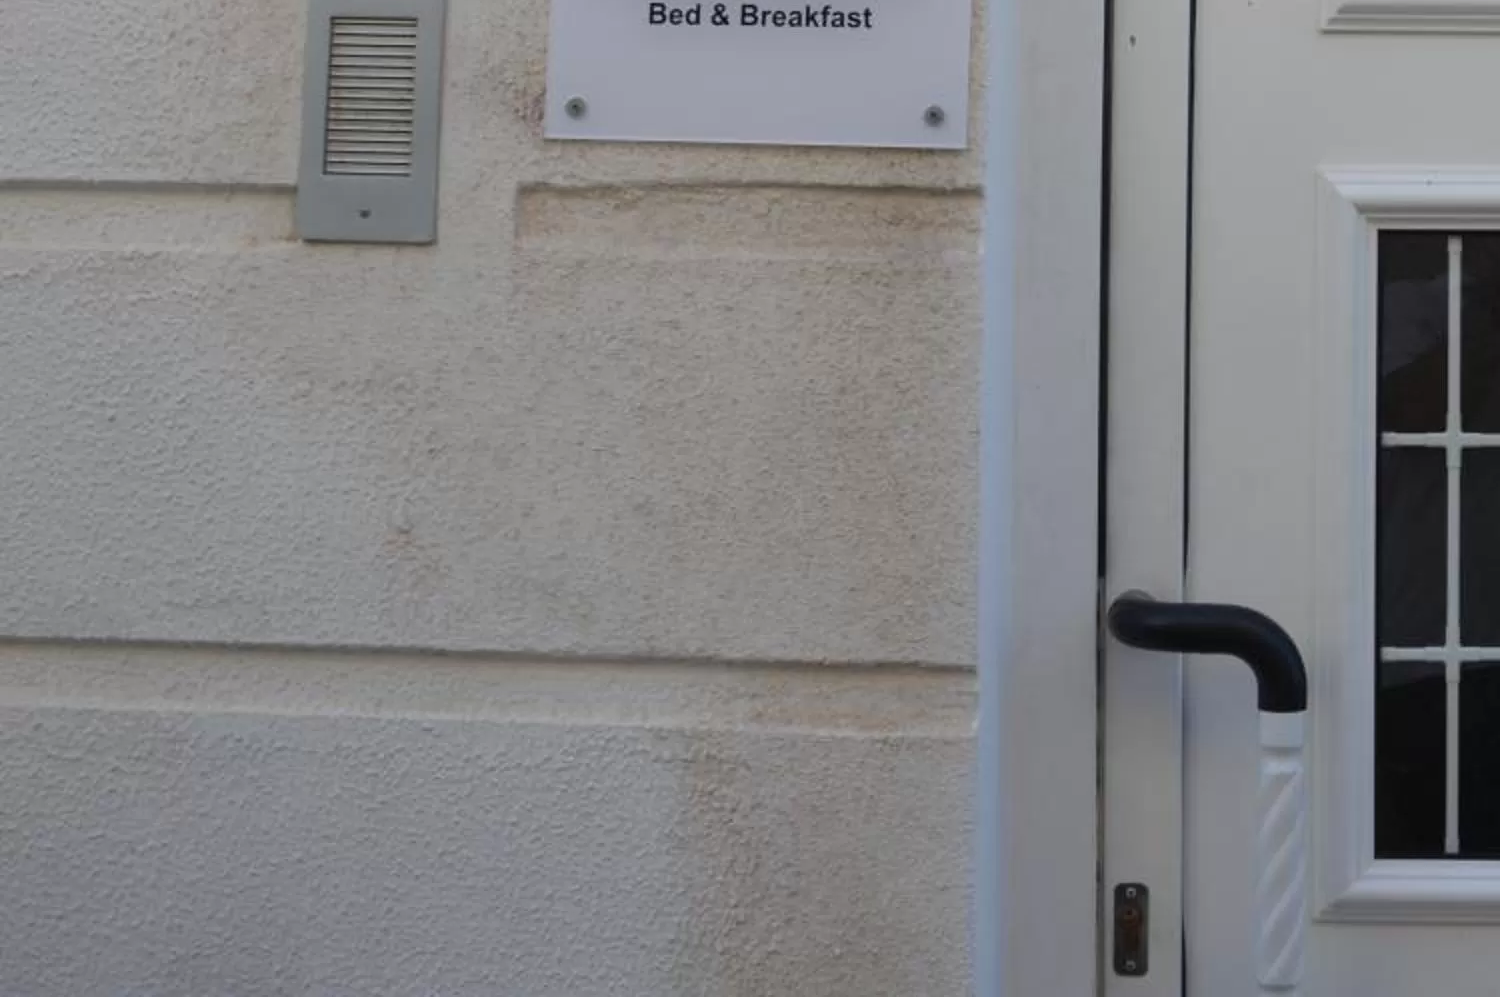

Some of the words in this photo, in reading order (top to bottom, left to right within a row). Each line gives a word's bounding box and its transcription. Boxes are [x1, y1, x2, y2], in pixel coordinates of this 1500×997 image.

[648, 2, 701, 26] Bed
[710, 4, 731, 27] &
[739, 3, 873, 29] Breakfast
